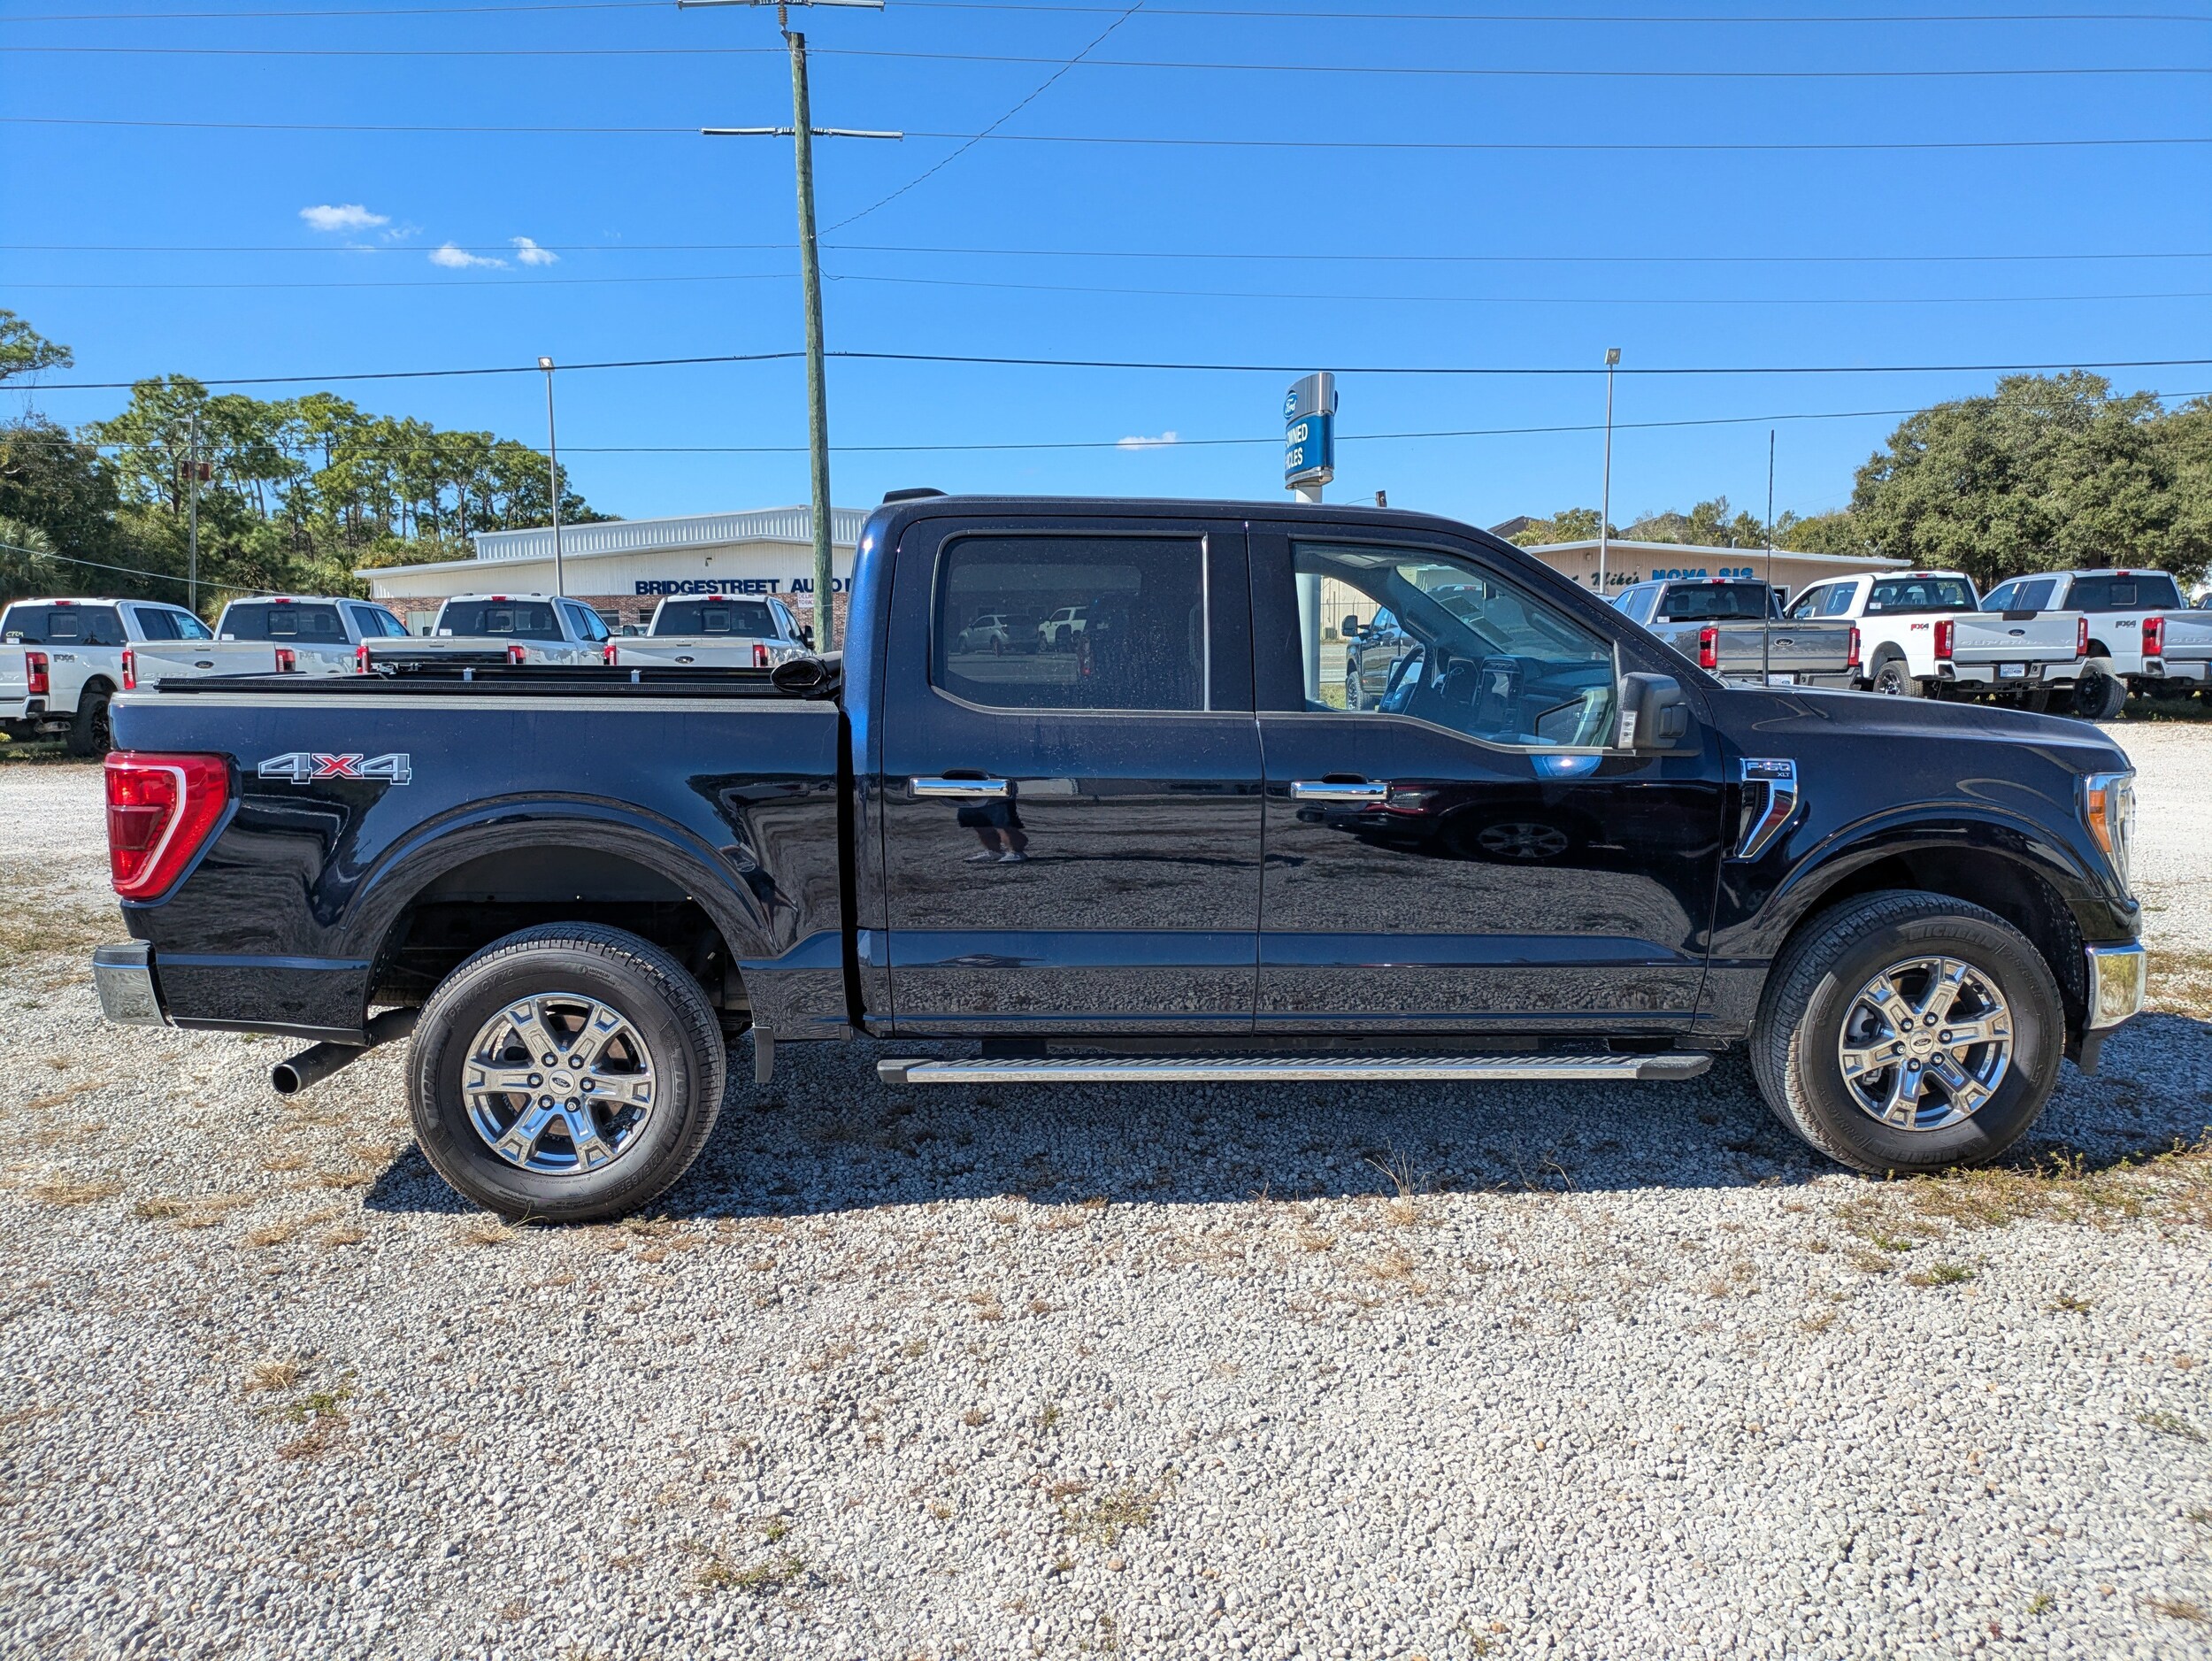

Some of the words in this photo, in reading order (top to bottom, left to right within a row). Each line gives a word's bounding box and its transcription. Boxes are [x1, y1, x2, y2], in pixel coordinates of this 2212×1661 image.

[635, 579, 780, 595] BRIDGESTREET
[790, 578, 842, 594] AUO
[1747, 762, 1791, 772] F-150
[1909, 925, 1996, 950] MICHELIN
[449, 974, 497, 1019] PRIMACY
